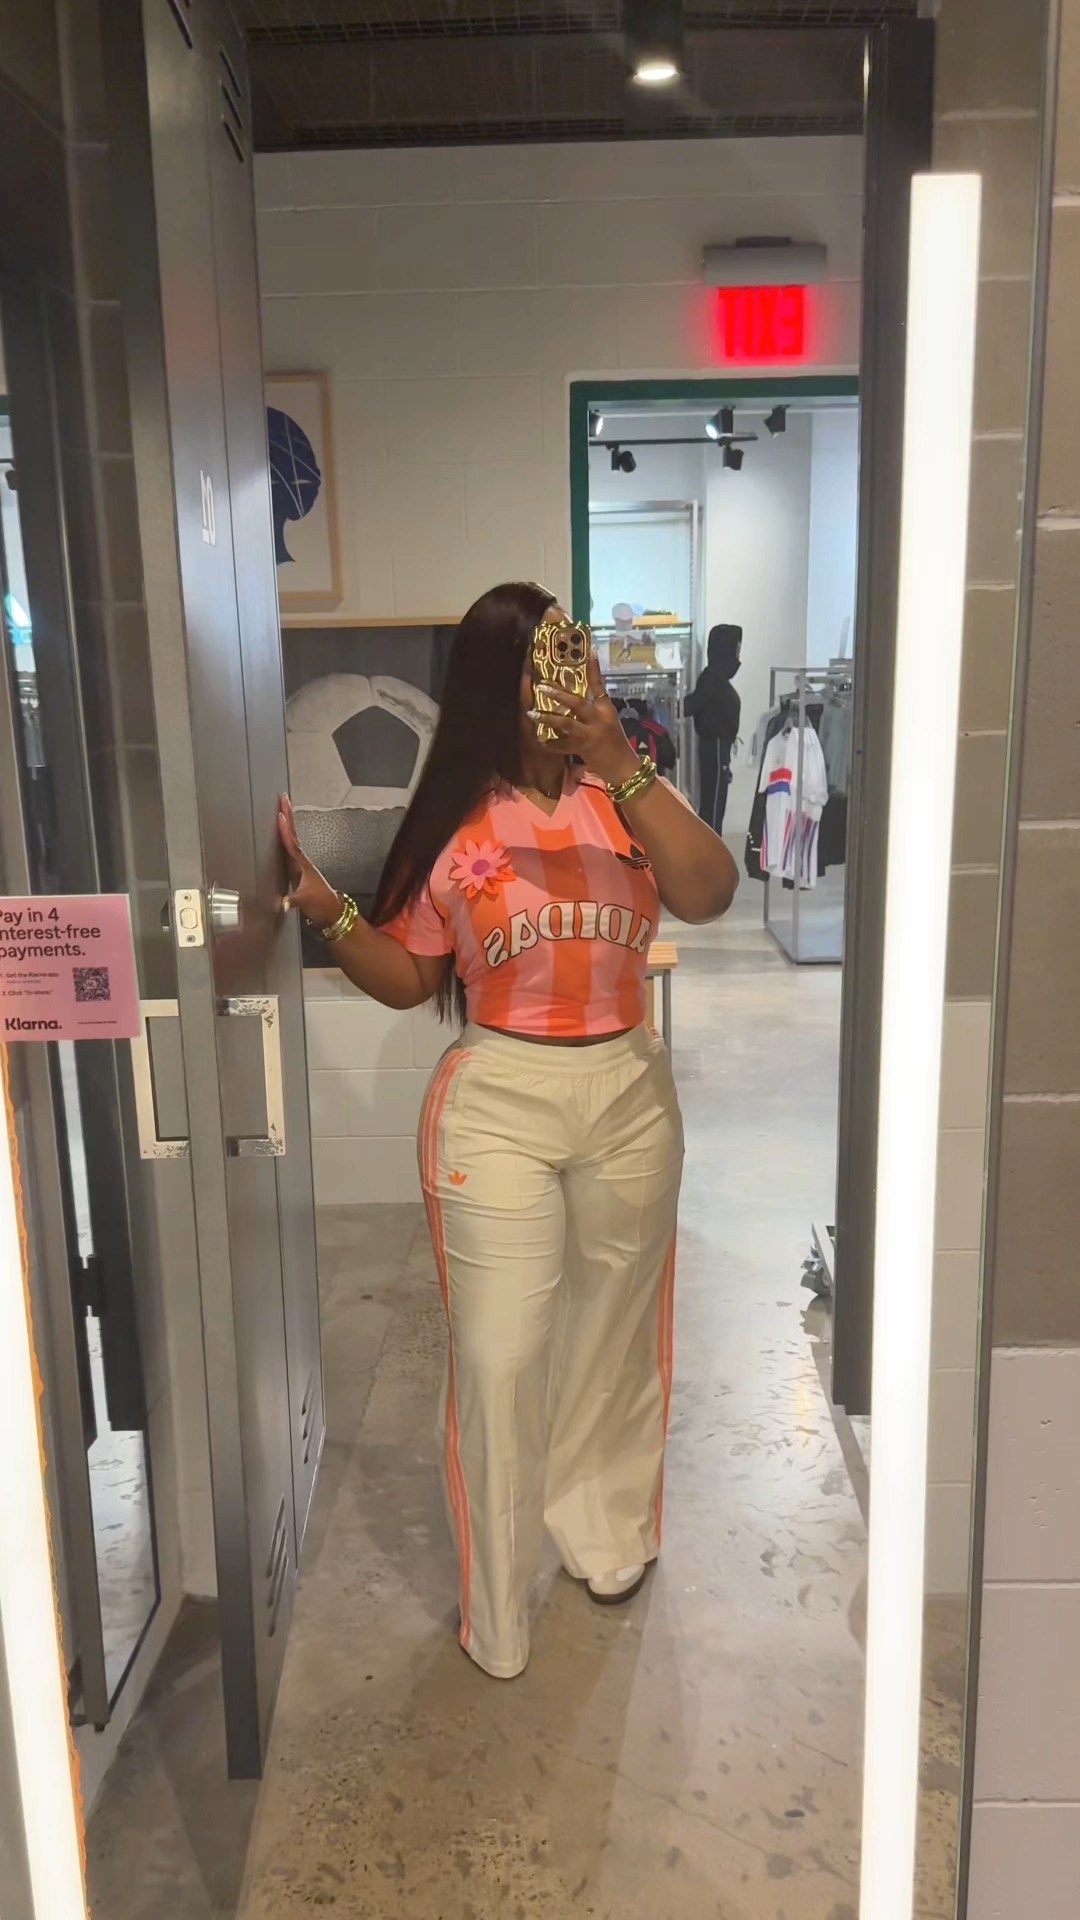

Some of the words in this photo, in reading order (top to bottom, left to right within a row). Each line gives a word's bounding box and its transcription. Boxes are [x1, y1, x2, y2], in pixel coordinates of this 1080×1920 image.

[27, 907, 43, 923] in
[48, 907, 60, 922] 4
[0, 924, 101, 941] nterest-free
[0, 942, 86, 961] payments.
[5, 1017, 62, 1031] Klarna.
